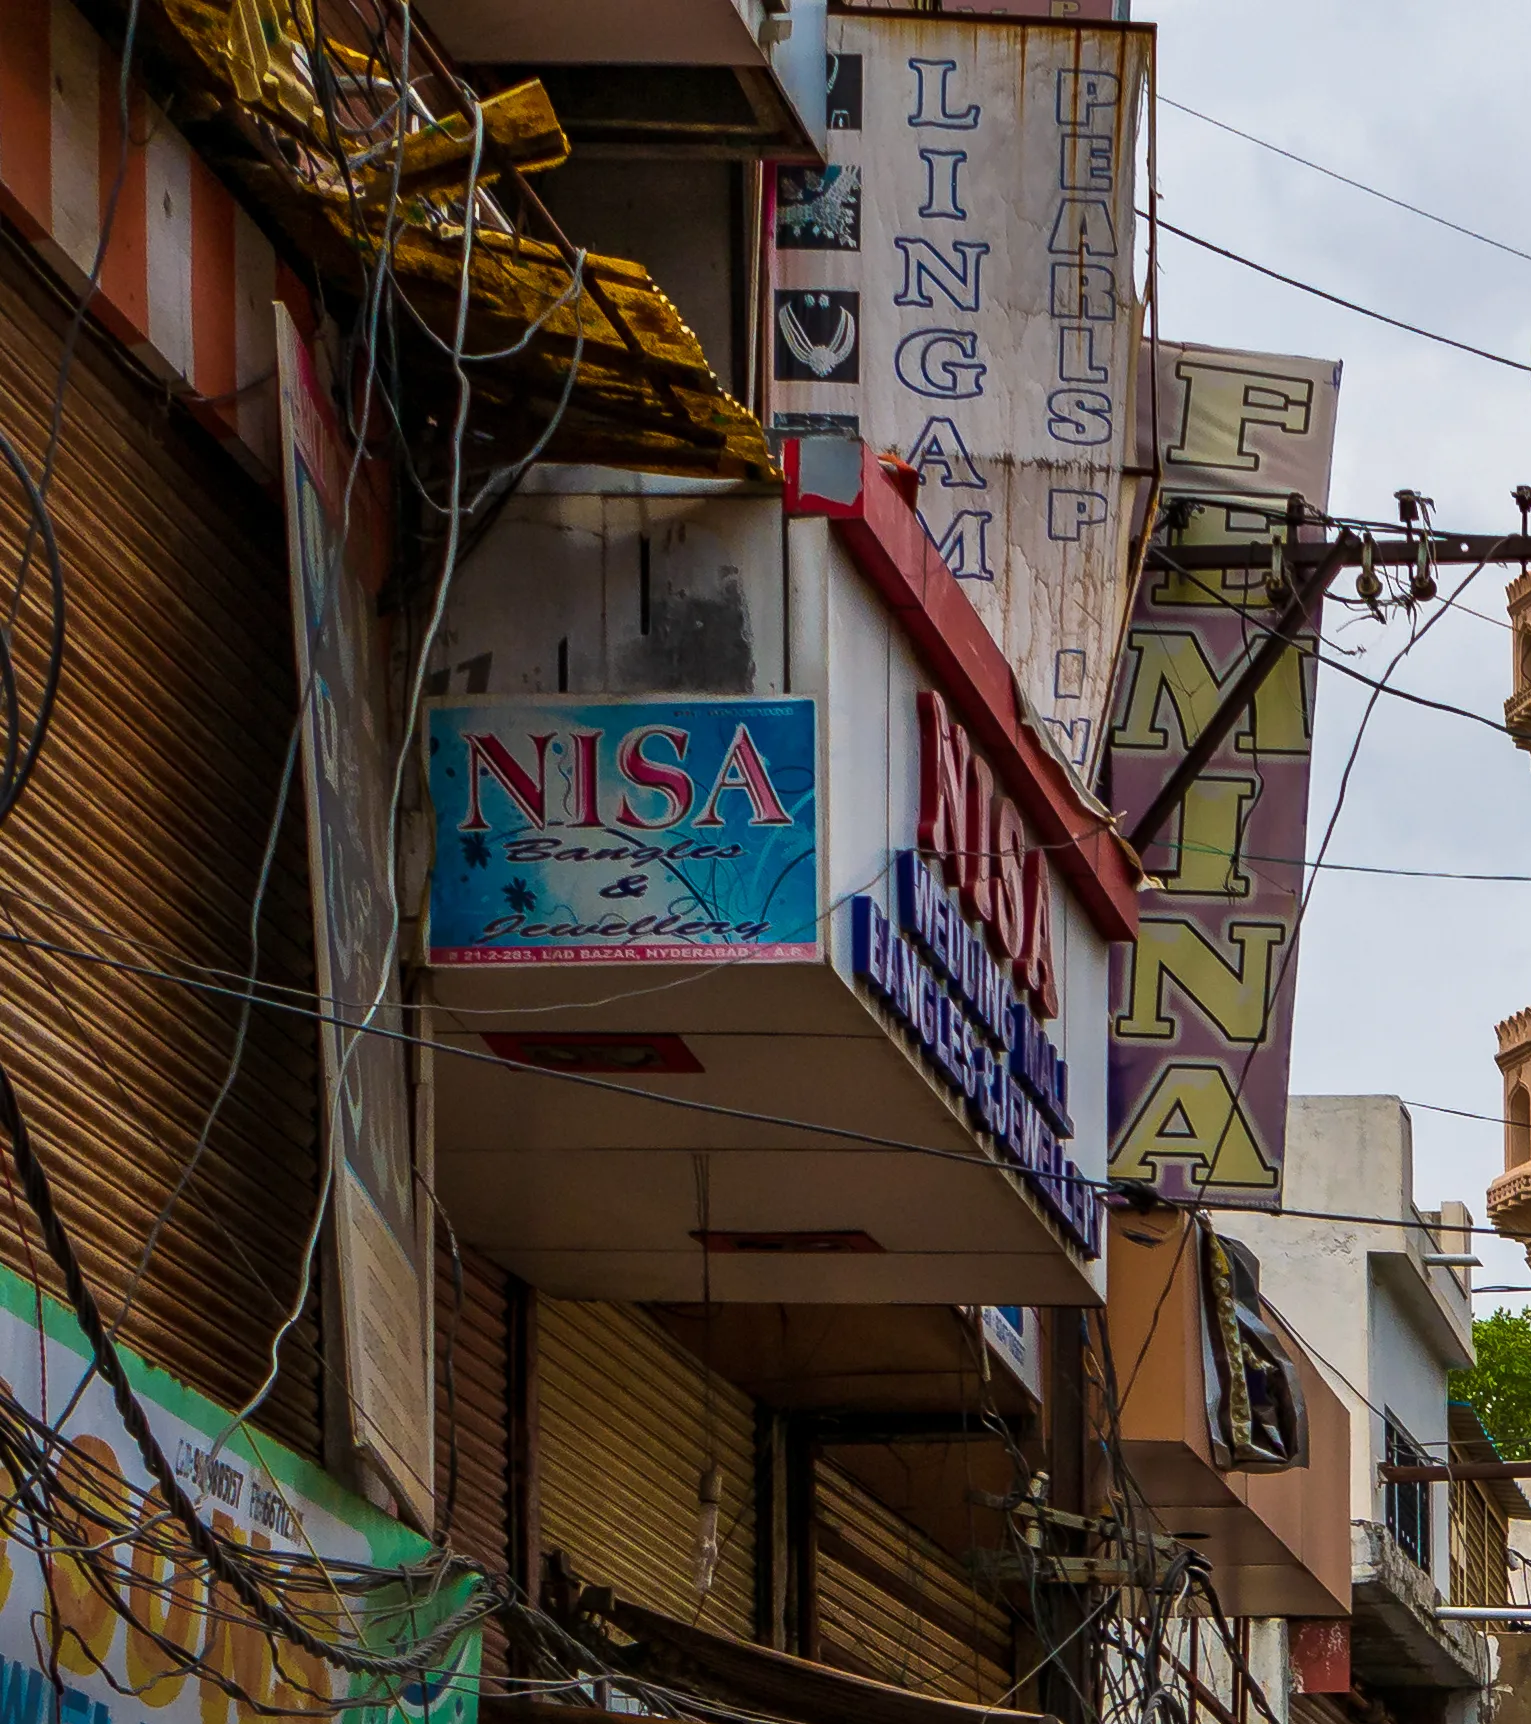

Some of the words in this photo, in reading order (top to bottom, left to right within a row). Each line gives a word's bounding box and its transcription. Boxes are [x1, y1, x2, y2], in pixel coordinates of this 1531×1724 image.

[1047, 67, 1120, 445] PEARLS
[458, 721, 794, 831] NISA
[501, 837, 747, 868] Bangles
[918, 690, 1058, 1019] NISA
[1109, 359, 1319, 1189] FEMINA
[473, 913, 775, 945] Jewellery
[599, 874, 650, 900] &
[898, 849, 1016, 1053] WEDDING
[852, 894, 977, 1099] BANGLES
[1010, 1002, 1075, 1139] MALL
